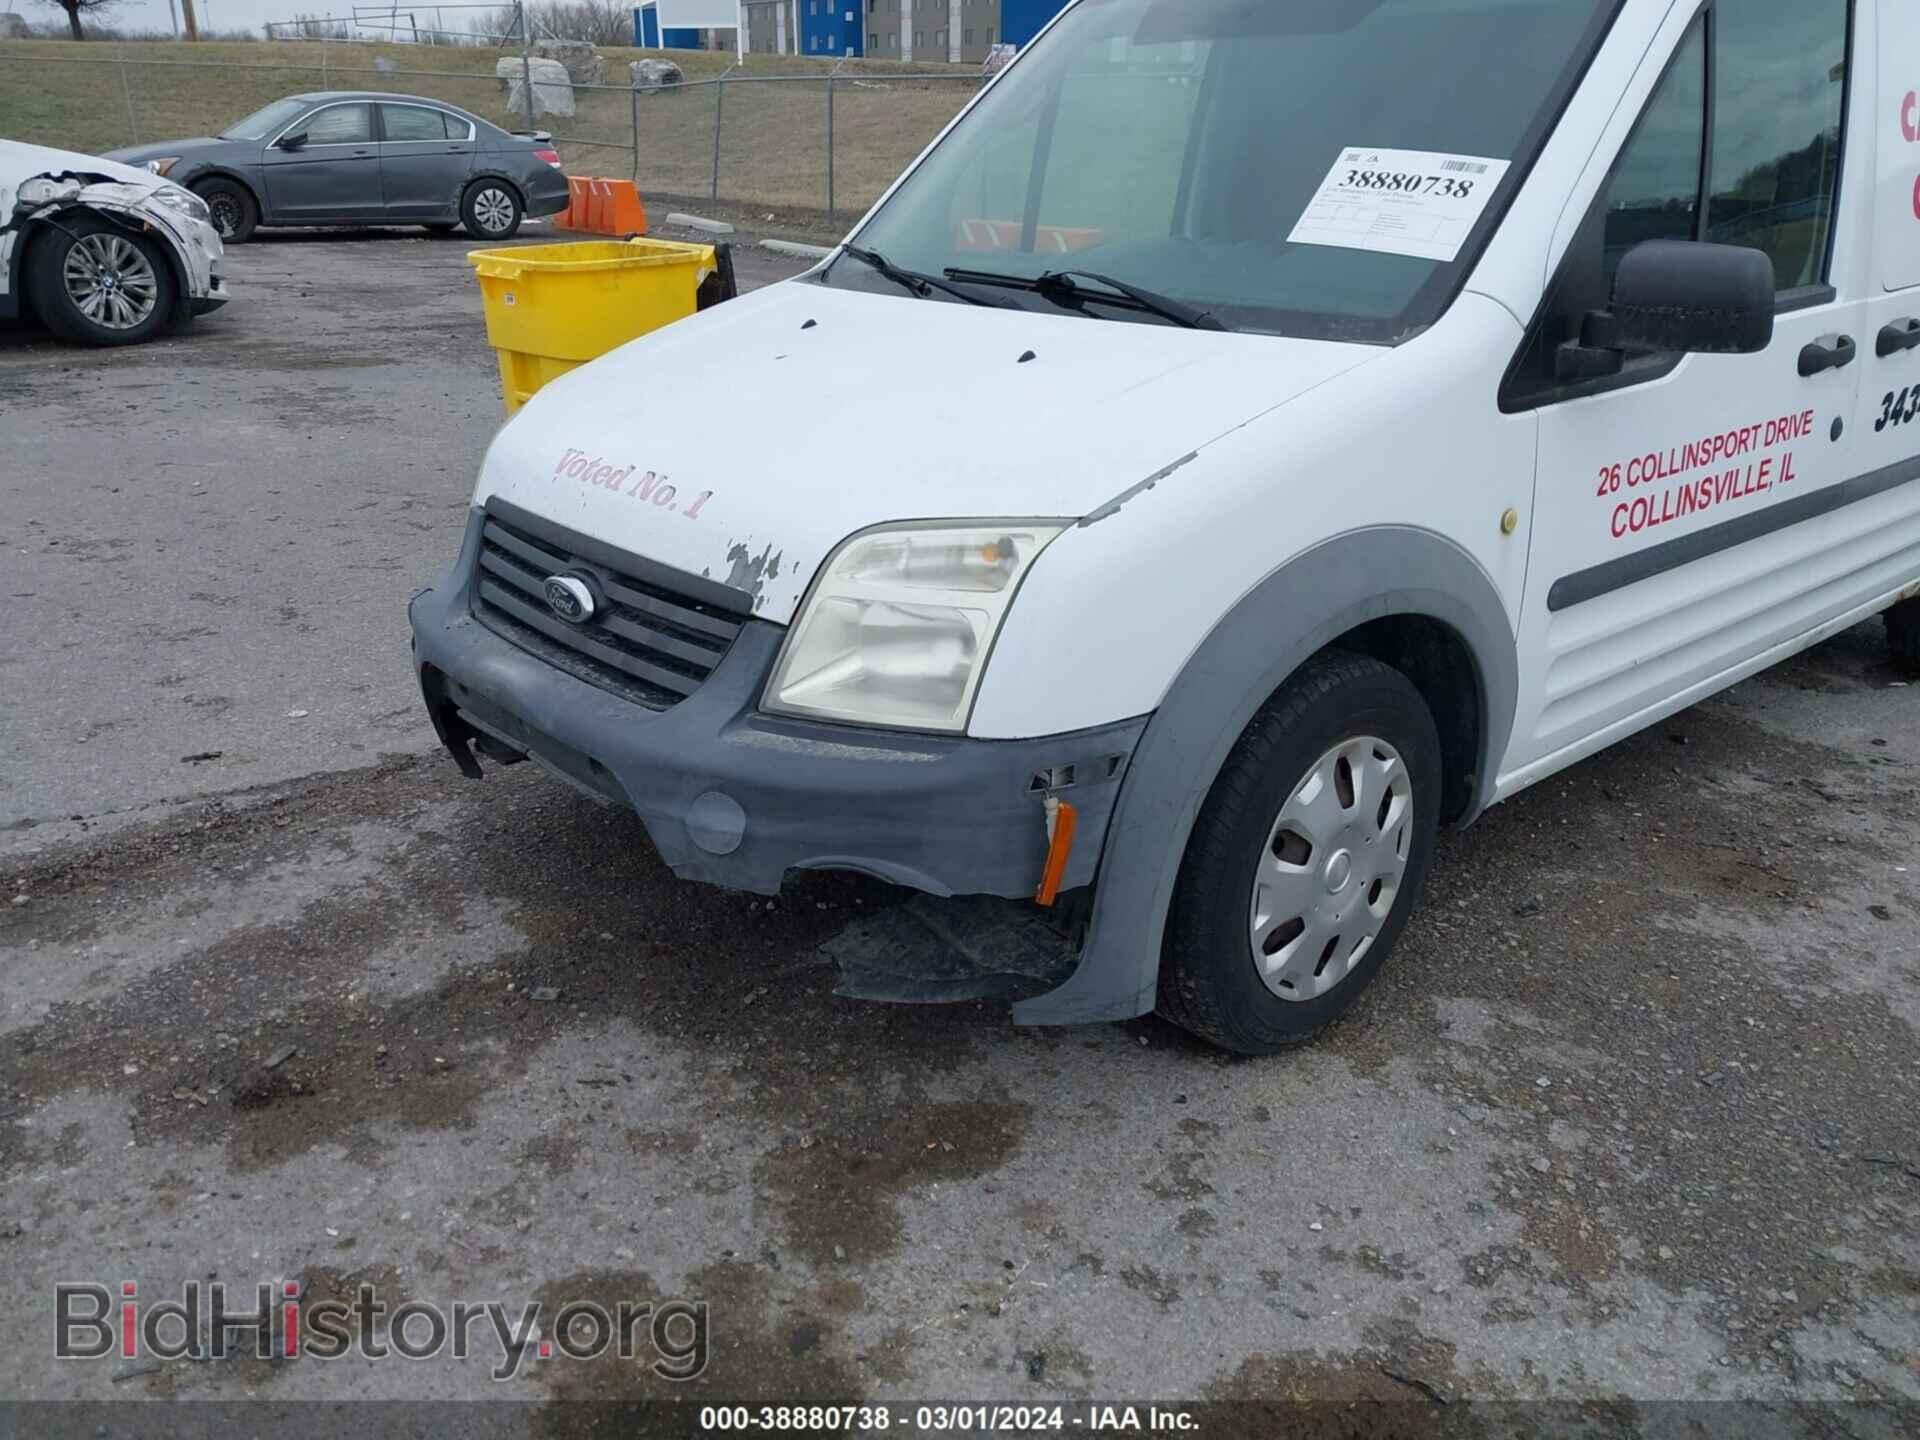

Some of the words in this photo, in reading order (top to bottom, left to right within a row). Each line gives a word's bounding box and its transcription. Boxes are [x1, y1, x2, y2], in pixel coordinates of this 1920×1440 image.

[1338, 169, 1474, 199] 38880738
[1874, 383, 1920, 433] 343
[555, 447, 636, 491] Voted
[626, 470, 677, 511] No.
[683, 490, 714, 520] 1
[1596, 463, 1621, 497] 26
[1626, 424, 1762, 487] COLLINSPORT
[1764, 409, 1814, 447] DRIVE
[1611, 458, 1773, 538] COLLINSVILLE,
[1779, 452, 1796, 483] IL
